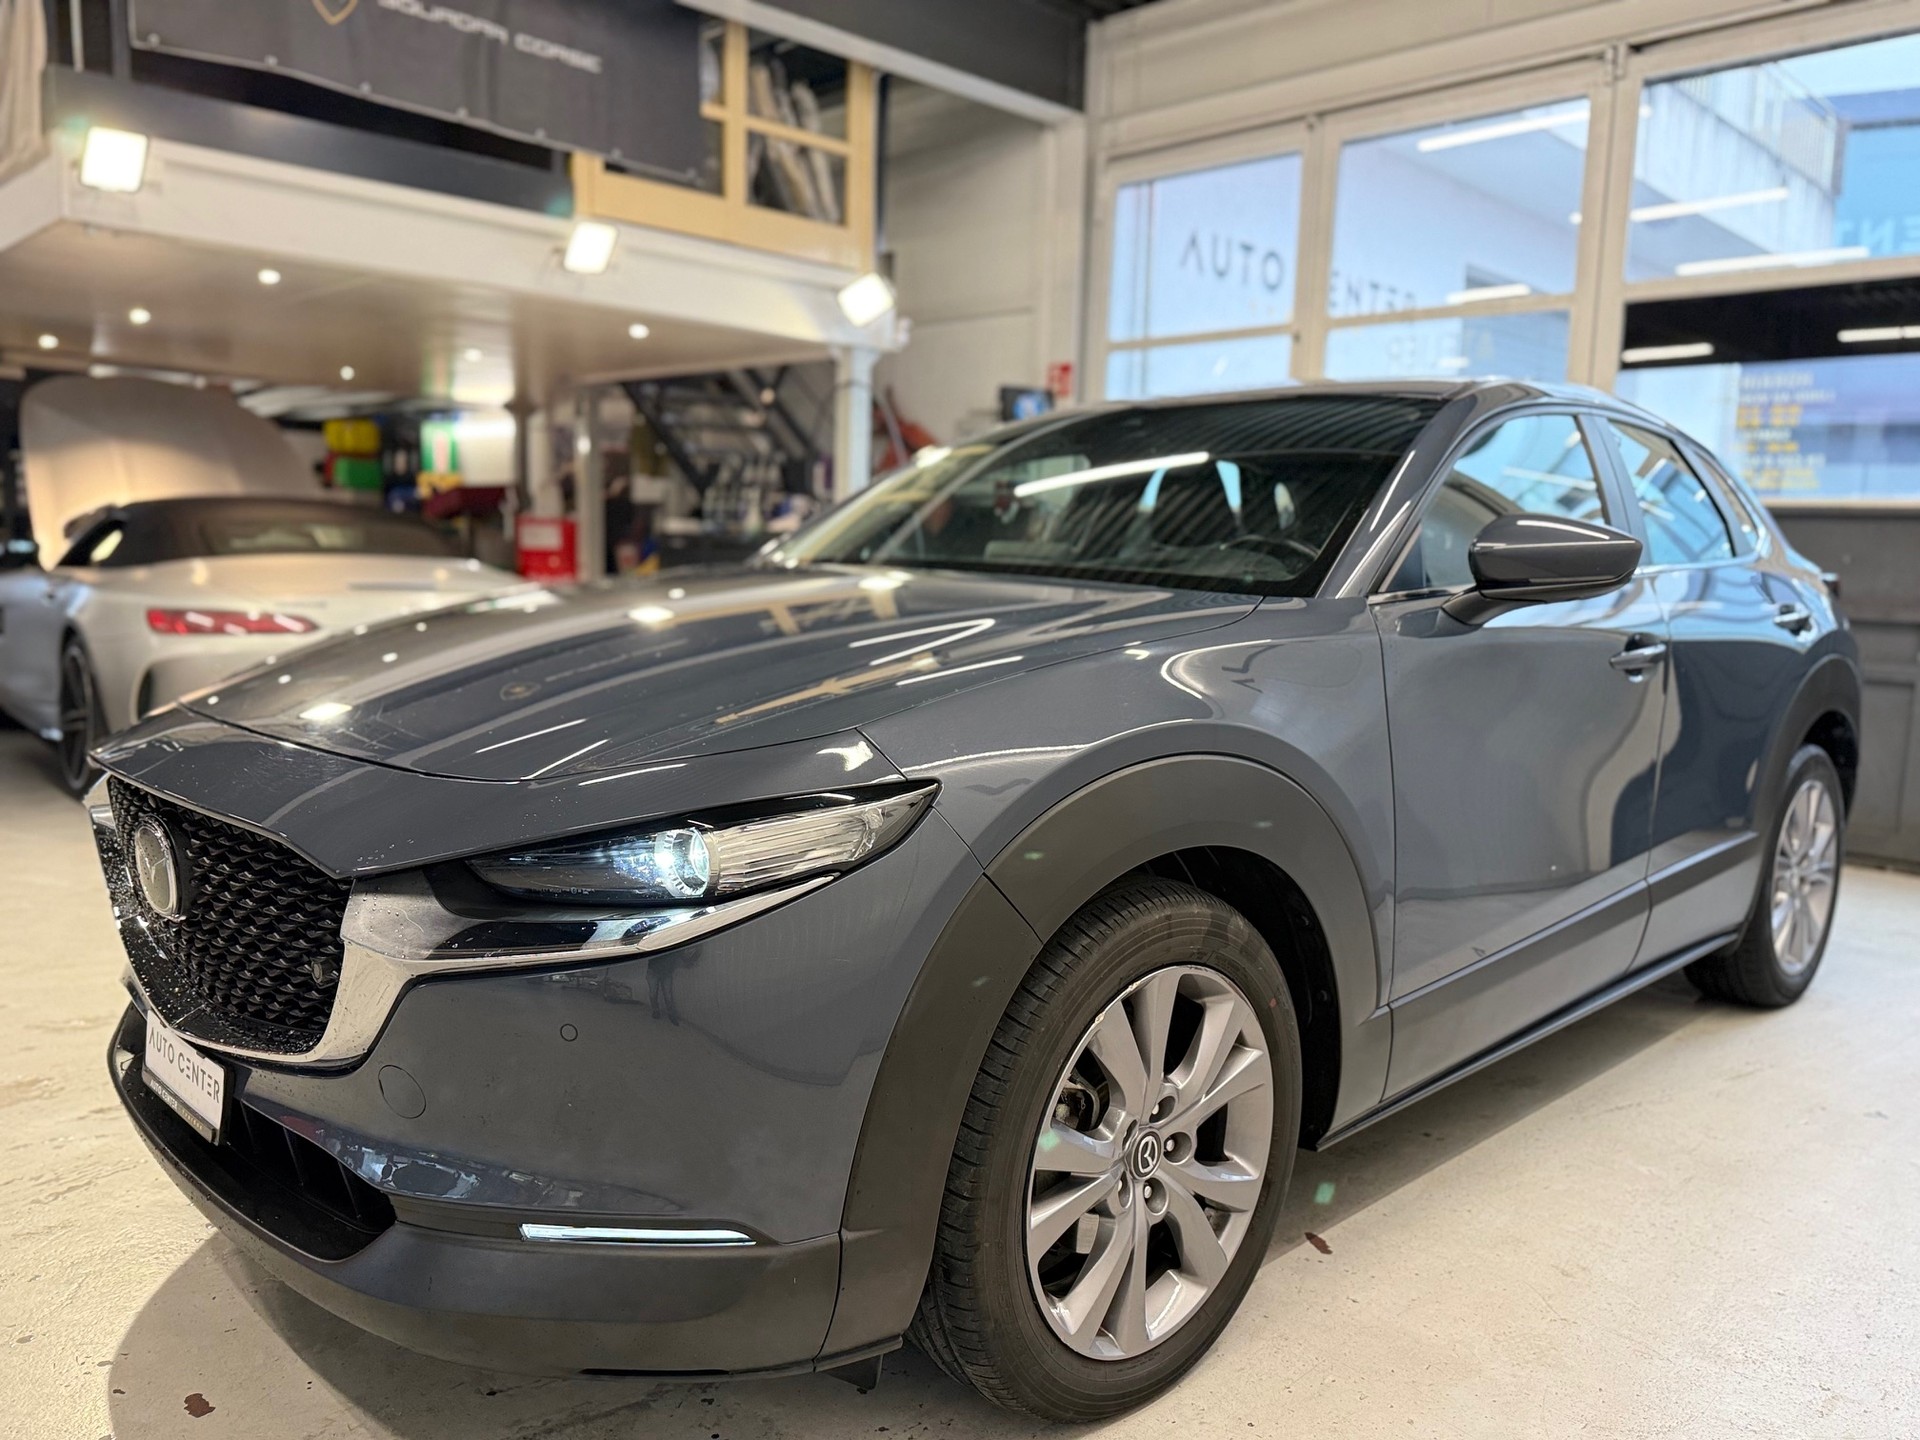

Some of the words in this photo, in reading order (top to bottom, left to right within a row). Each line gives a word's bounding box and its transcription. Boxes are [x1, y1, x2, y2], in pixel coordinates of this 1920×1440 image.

[1180, 229, 1285, 294] AUTO
[149, 1026, 175, 1065] AUTO
[178, 1052, 220, 1104] CENTER
